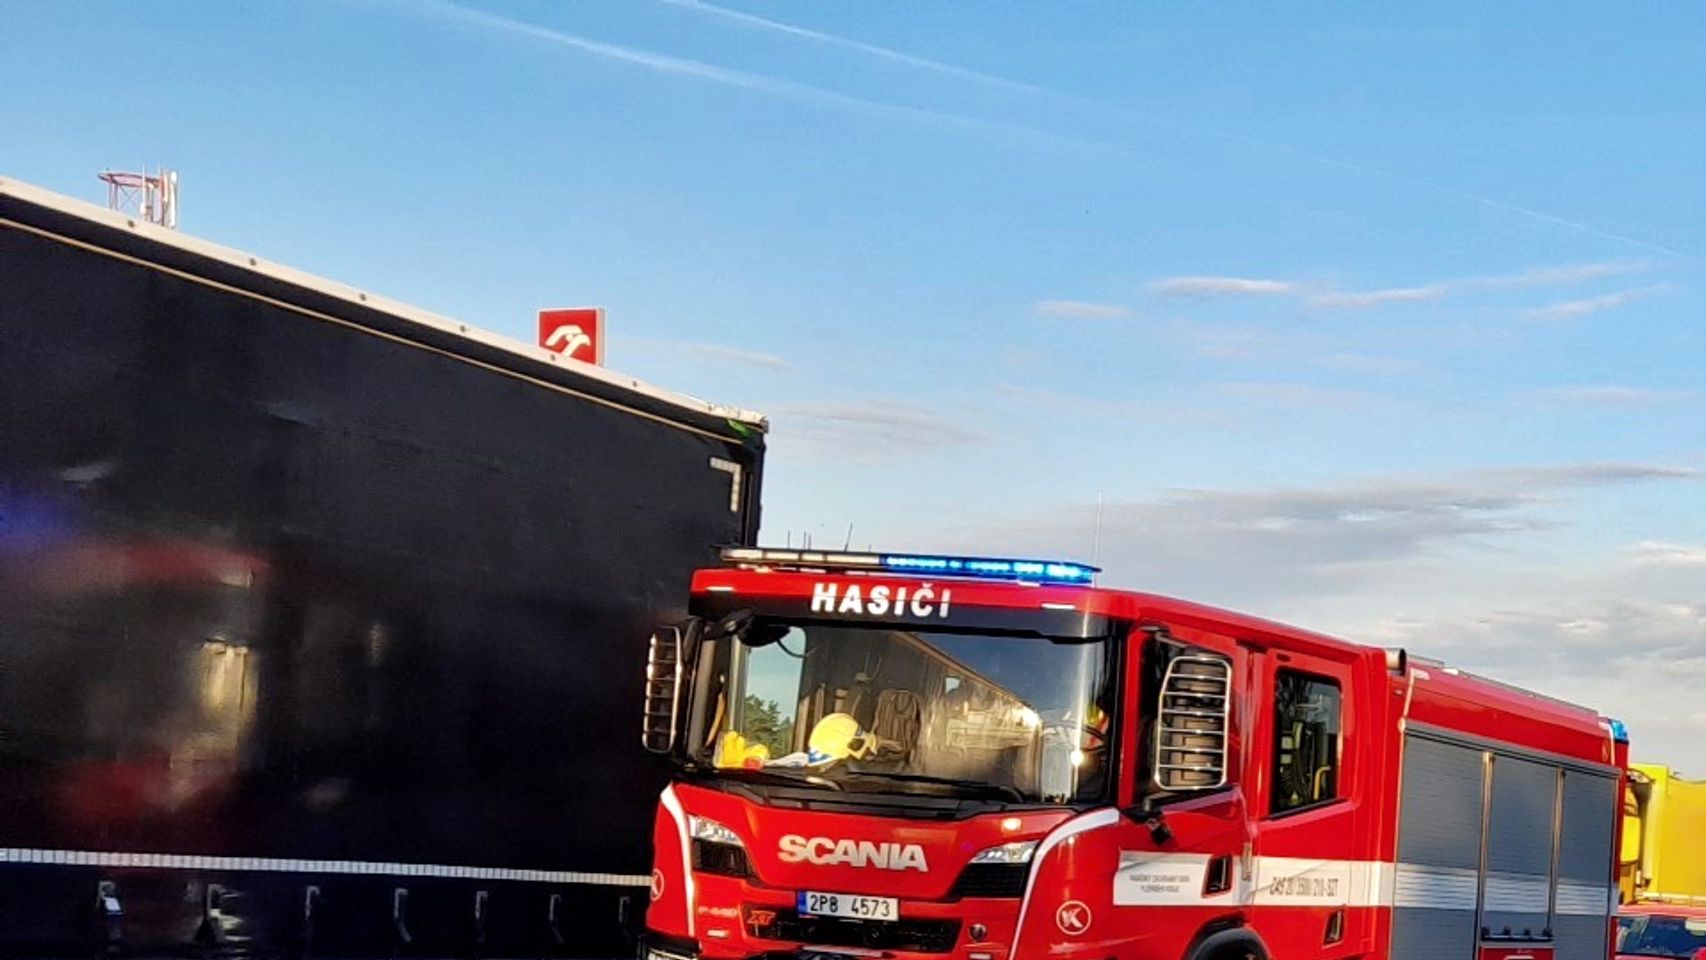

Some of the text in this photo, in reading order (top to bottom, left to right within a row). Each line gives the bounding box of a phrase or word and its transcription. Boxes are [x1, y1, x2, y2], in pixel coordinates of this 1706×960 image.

[810, 582, 951, 618] HASIČI
[777, 834, 928, 872] SCANIA
[810, 894, 890, 917] 2P8 4573
